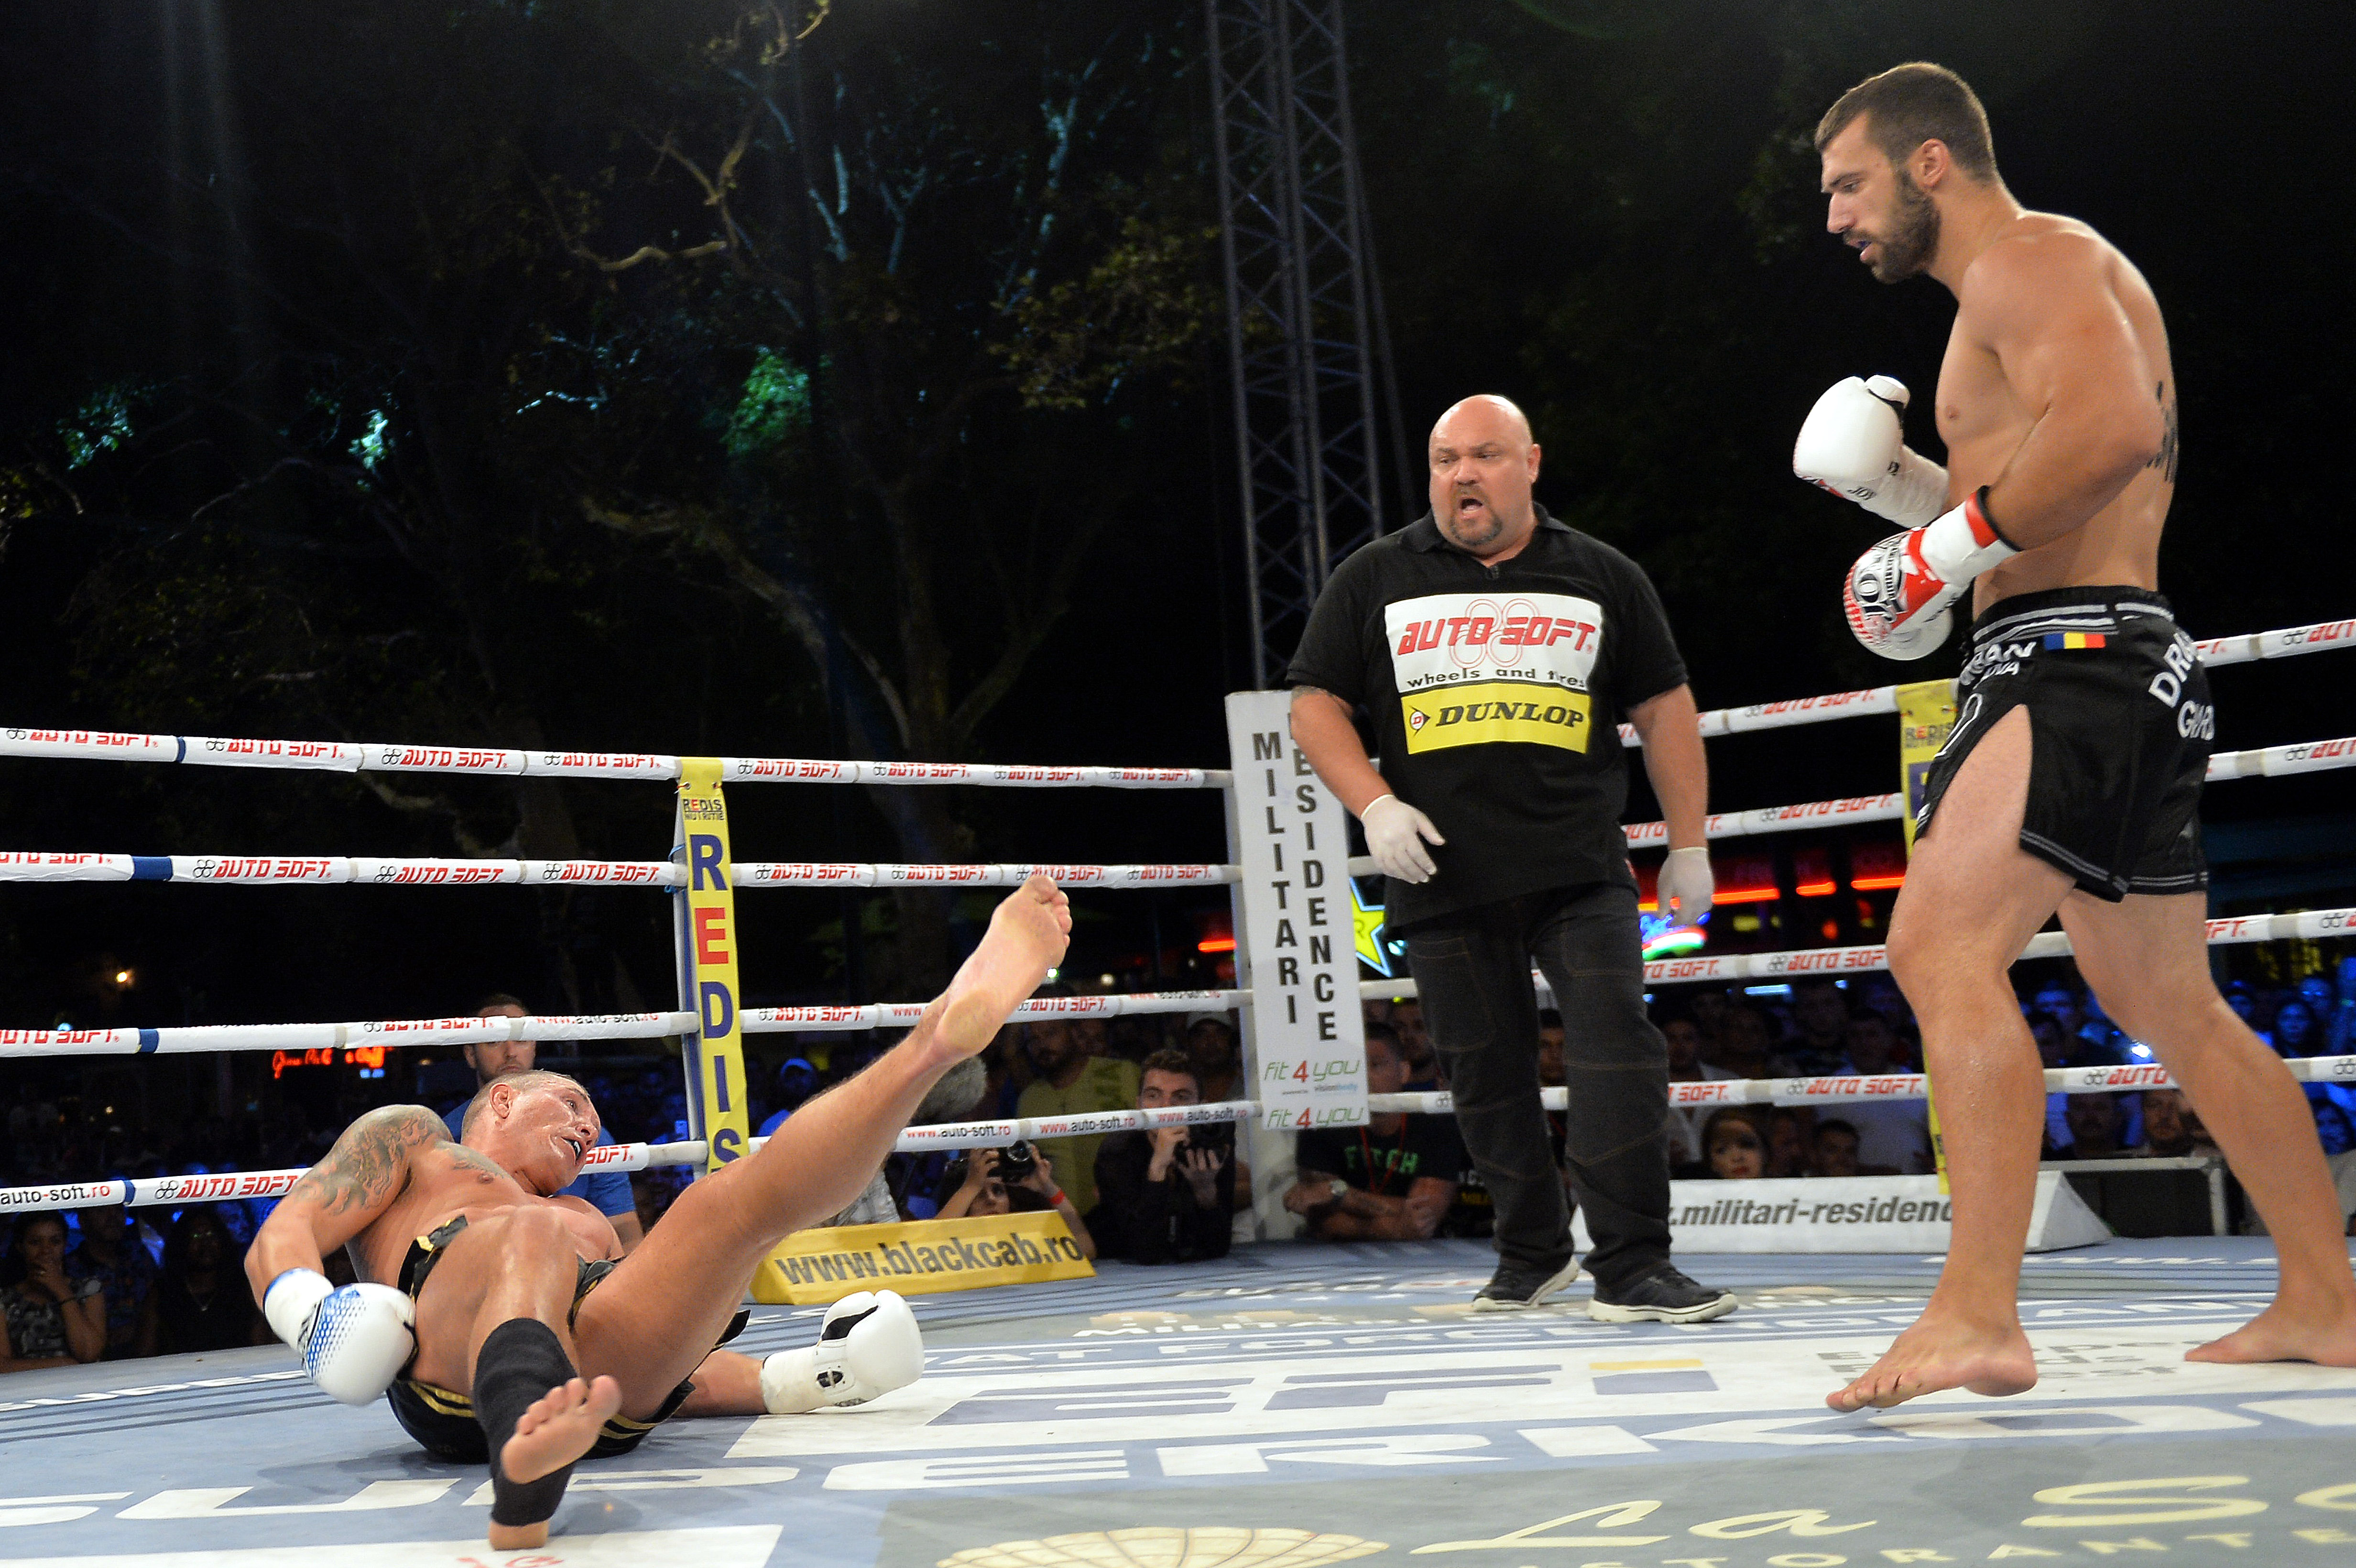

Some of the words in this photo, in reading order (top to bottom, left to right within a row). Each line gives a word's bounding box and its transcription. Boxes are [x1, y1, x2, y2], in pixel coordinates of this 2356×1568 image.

[1397, 617, 1494, 655] AUTO
[2308, 621, 2356, 642] AUT
[1407, 668, 1480, 688] wheels
[1496, 668, 1536, 679] and
[1436, 701, 1584, 728] DUNLOP
[227, 738, 282, 755] AUTO
[2311, 739, 2356, 759] AUT
[400, 749, 452, 767] AUTO
[562, 753, 608, 767] AUTO
[753, 760, 796, 777] AUTO
[888, 763, 927, 777] AUTO
[683, 798, 722, 812] REDIS
[1779, 800, 1834, 820] AUTO
[0, 851, 41, 864] UTO
[214, 859, 272, 878] AUTO
[394, 866, 449, 883] AUTO
[560, 863, 609, 881] AUTO
[771, 864, 814, 880] AUTO
[907, 866, 945, 881] AUTO
[1141, 865, 1174, 880] AUTO
[1253, 731, 1299, 1024] MILITARI
[1287, 712, 1338, 1041] ESIDENCE
[1788, 952, 1841, 971] AUTO
[1845, 949, 1886, 968] SOF
[690, 834, 742, 1163] REDIS
[1026, 996, 1067, 1012] AUTO
[775, 1006, 817, 1021] AUTO
[0, 1029, 50, 1045] UTO
[1293, 1060, 1309, 1083] 4
[1313, 1060, 1360, 1081] you
[2107, 1066, 2168, 1085] AUTO
[1807, 1078, 1862, 1095] AUTO
[1296, 1107, 1311, 1130] 4
[177, 1177, 237, 1198] AUTO
[774, 1232, 1085, 1285] www.blackcab.ro
